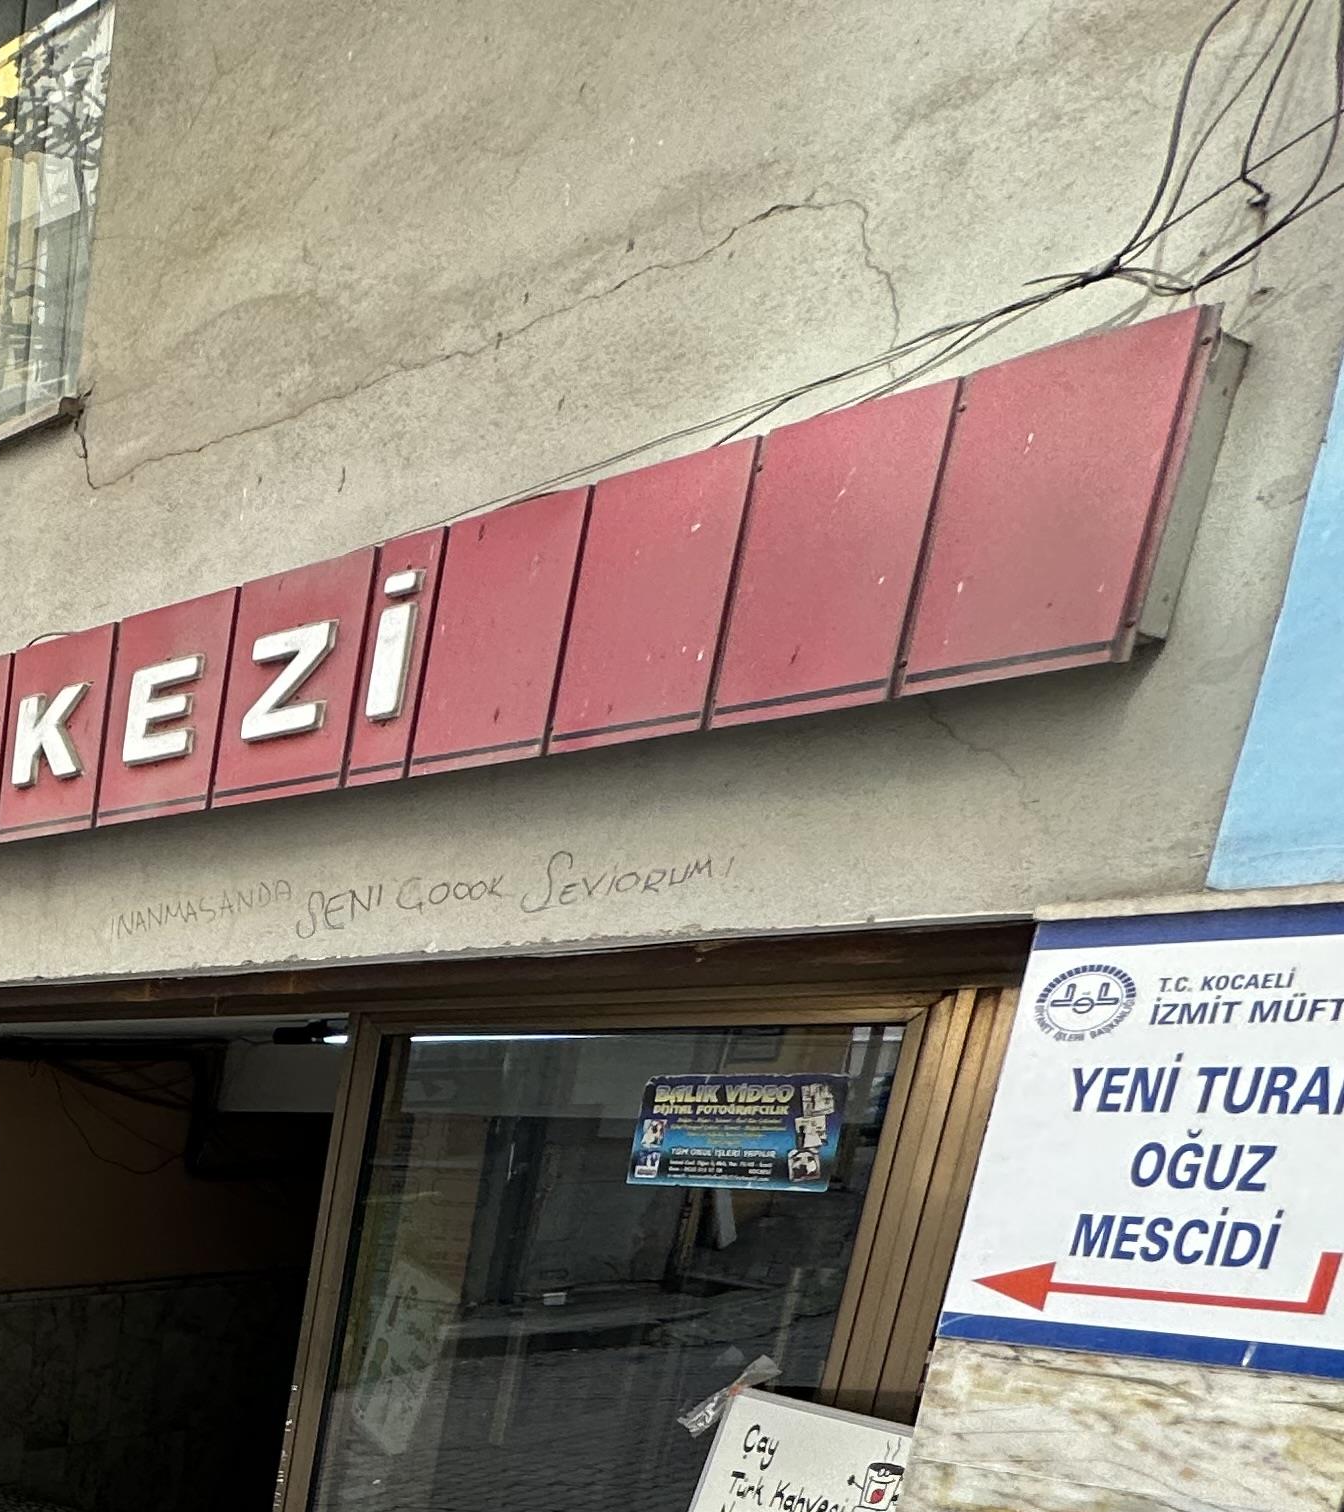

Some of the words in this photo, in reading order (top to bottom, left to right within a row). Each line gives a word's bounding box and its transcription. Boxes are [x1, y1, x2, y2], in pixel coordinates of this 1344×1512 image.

[1159, 976, 1193, 993] T.C.
[1200, 967, 1297, 992] KOCAELİ
[1149, 995, 1242, 1026] İZMİT
[654, 1084, 720, 1103] BALIK
[1072, 1052, 1184, 1113] YENİ
[1197, 1066, 1344, 1115] TURA
[1130, 1128, 1278, 1192] OĞUZ
[1069, 1206, 1285, 1270] MESCİDİ
[742, 1424, 780, 1470] Çay
[728, 1471, 764, 1506] Türk
